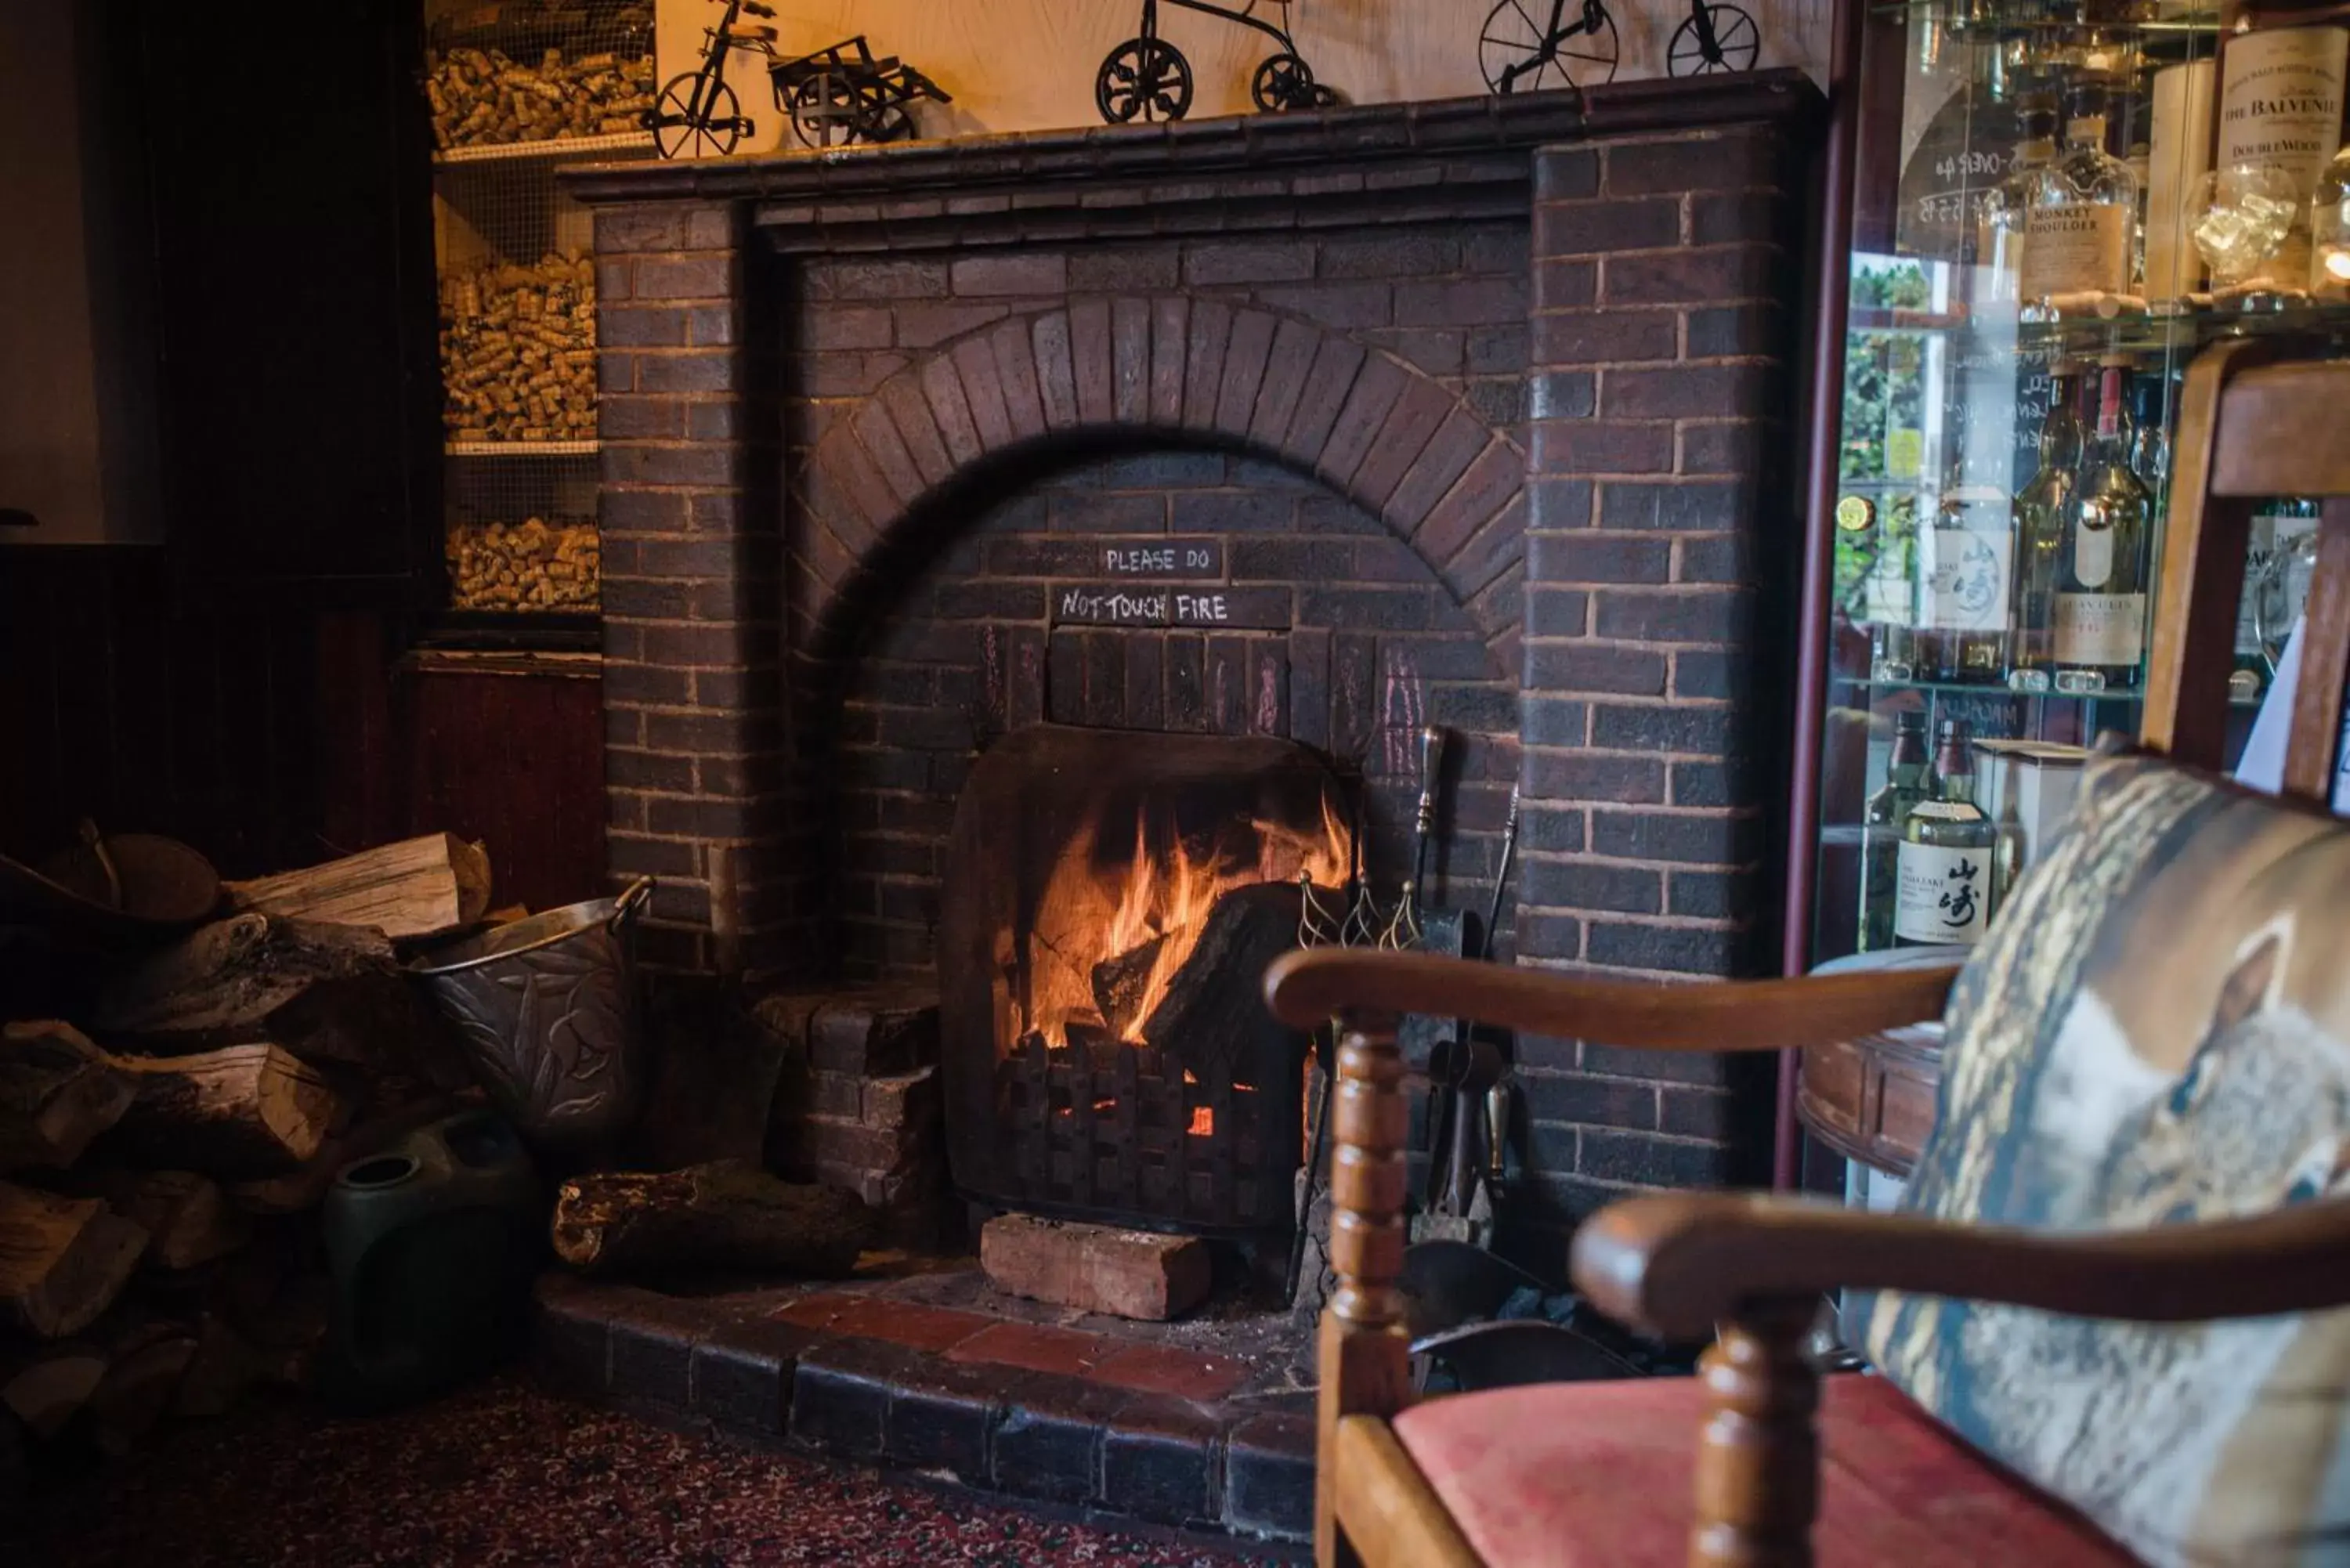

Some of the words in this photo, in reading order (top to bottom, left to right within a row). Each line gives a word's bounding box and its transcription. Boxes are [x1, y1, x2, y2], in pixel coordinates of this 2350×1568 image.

[2251, 98, 2337, 117] BALVENIE
[2034, 207, 2091, 222] MONKEY
[2030, 220, 2099, 234] SHOULDER
[1107, 549, 1175, 572] PLEASE
[1187, 550, 1209, 569] DO
[1063, 592, 1103, 620] NOT
[1105, 593, 1166, 620] TOUCH
[1177, 594, 1228, 620] FIRE
